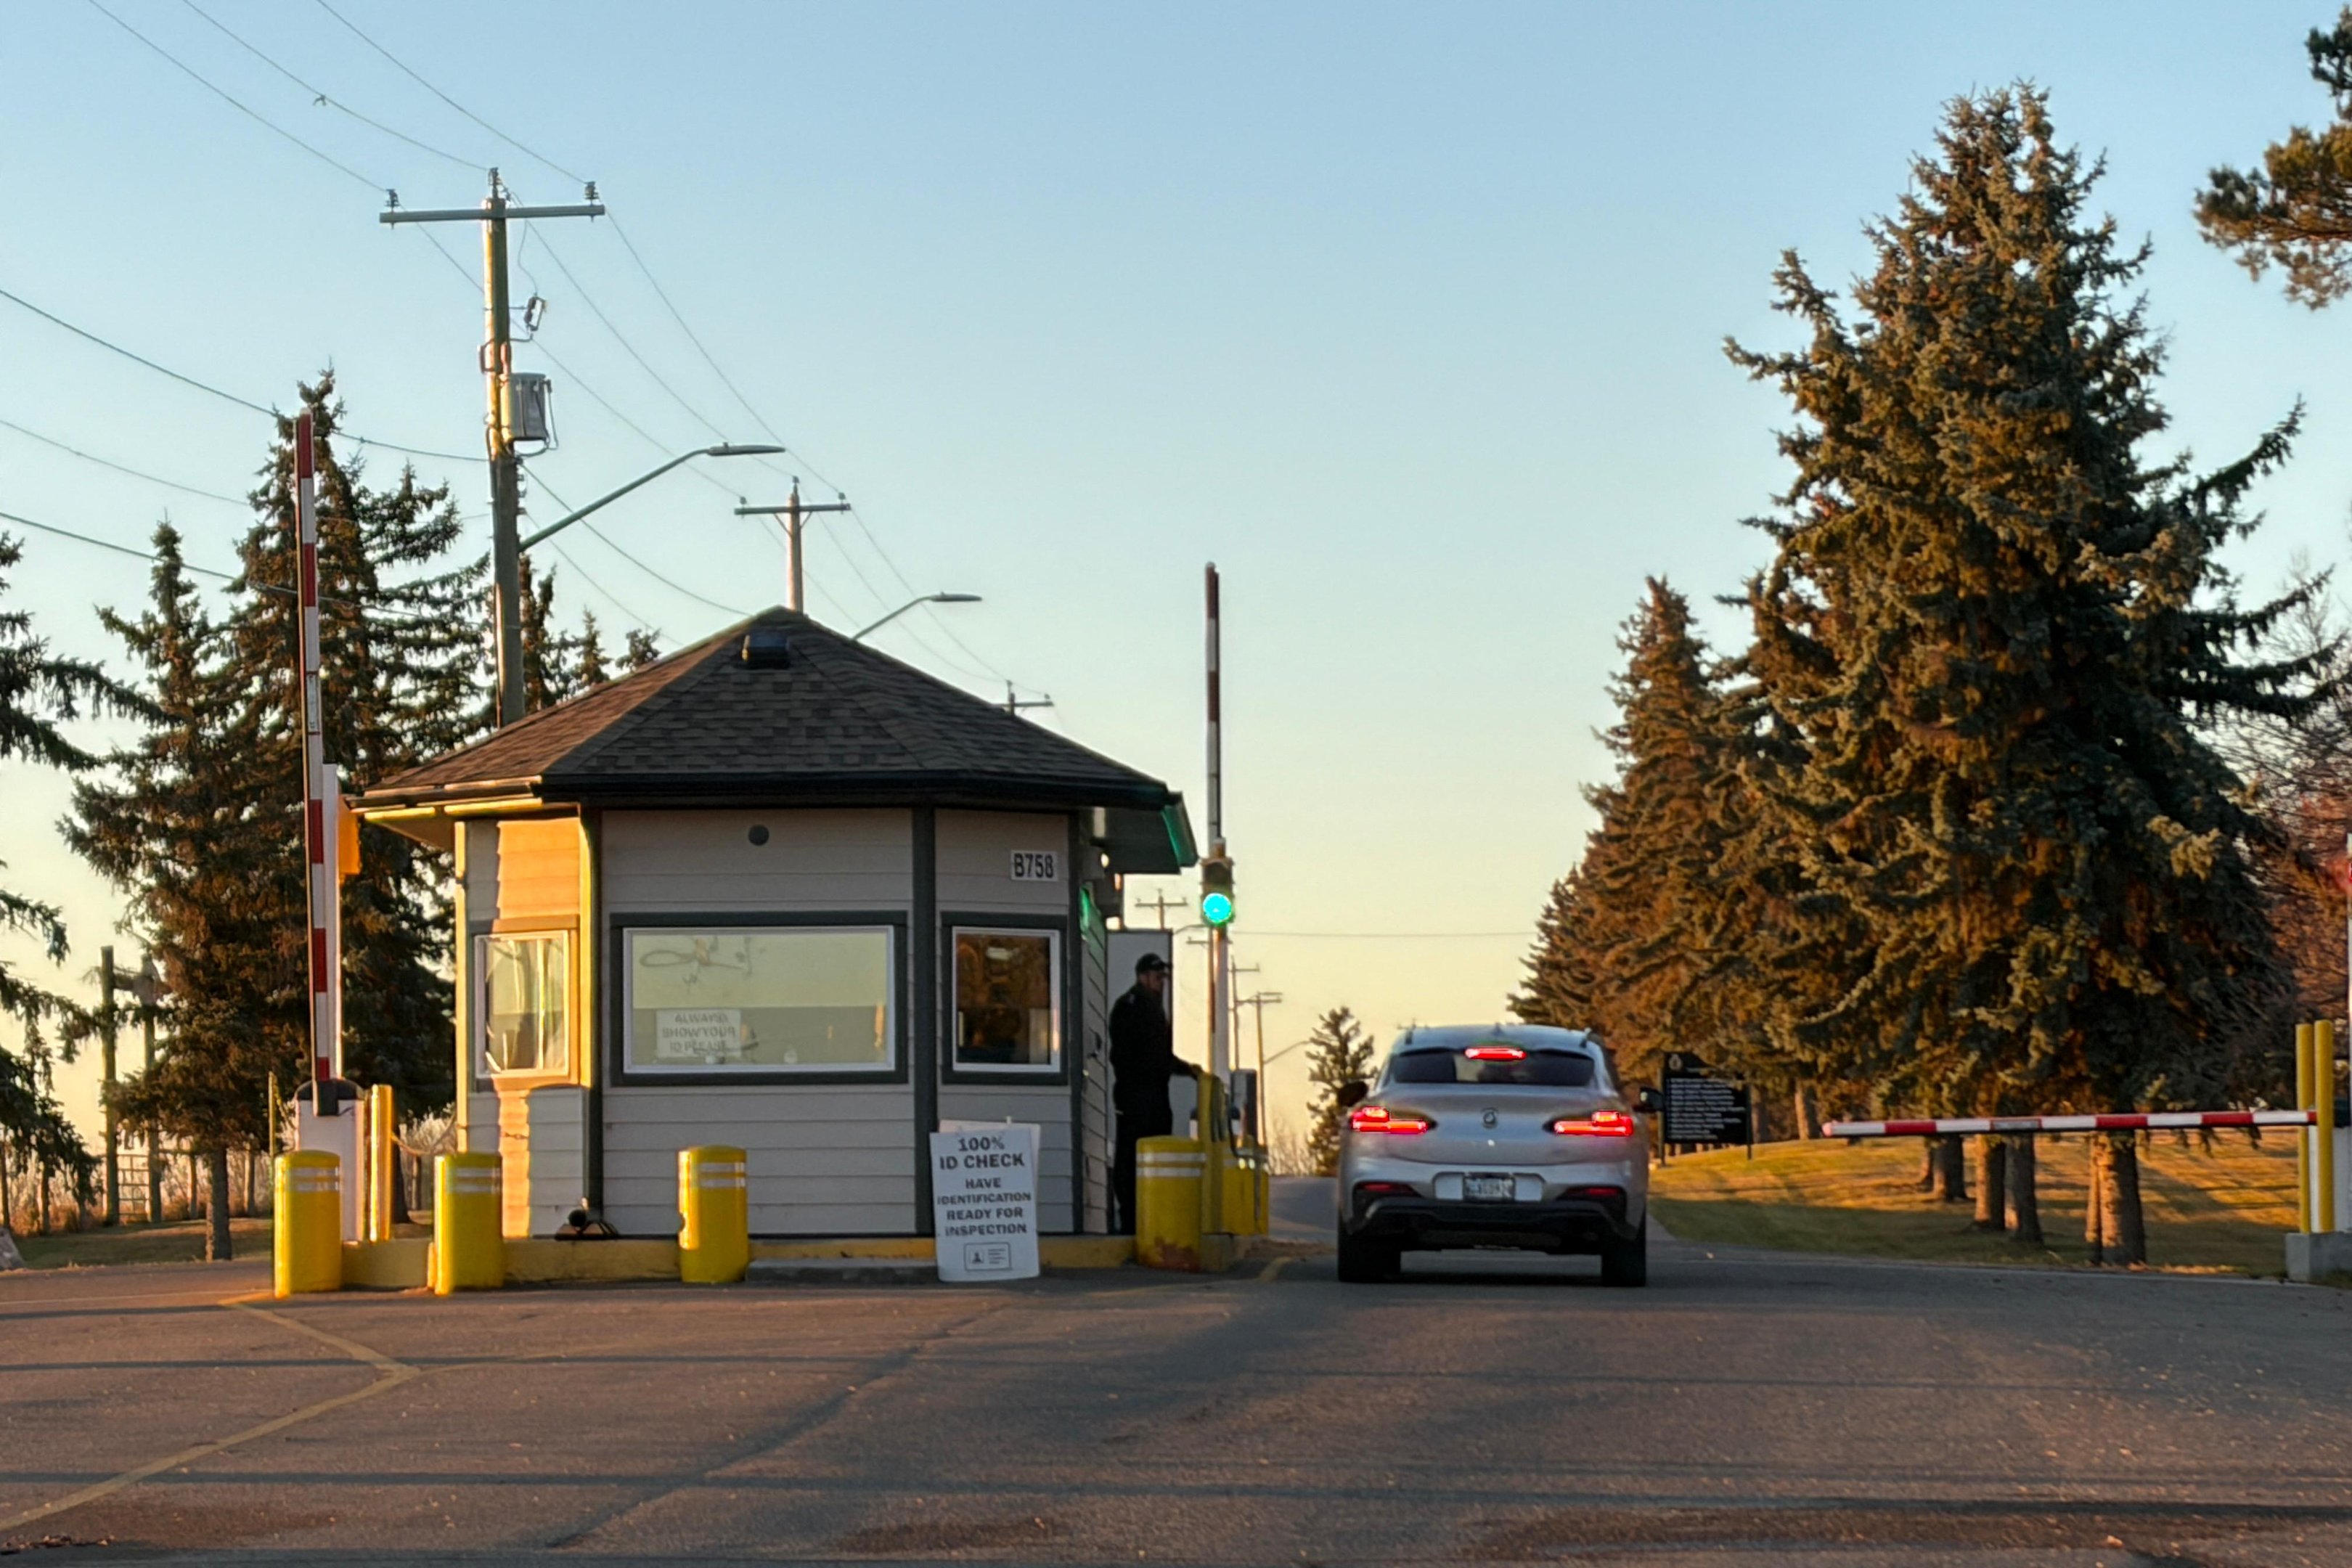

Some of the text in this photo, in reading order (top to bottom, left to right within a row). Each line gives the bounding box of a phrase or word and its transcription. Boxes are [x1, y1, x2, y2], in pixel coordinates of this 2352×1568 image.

[1014, 853, 1053, 878] B758
[958, 1136, 1005, 1152] 100%
[939, 1153, 1025, 1169] ID CHECK
[965, 1177, 1002, 1189] HAVE
[937, 1192, 1032, 1205] IDENTIFICATION
[947, 1206, 1024, 1220] READY FOR
[944, 1223, 1027, 1236] INSPECTION
